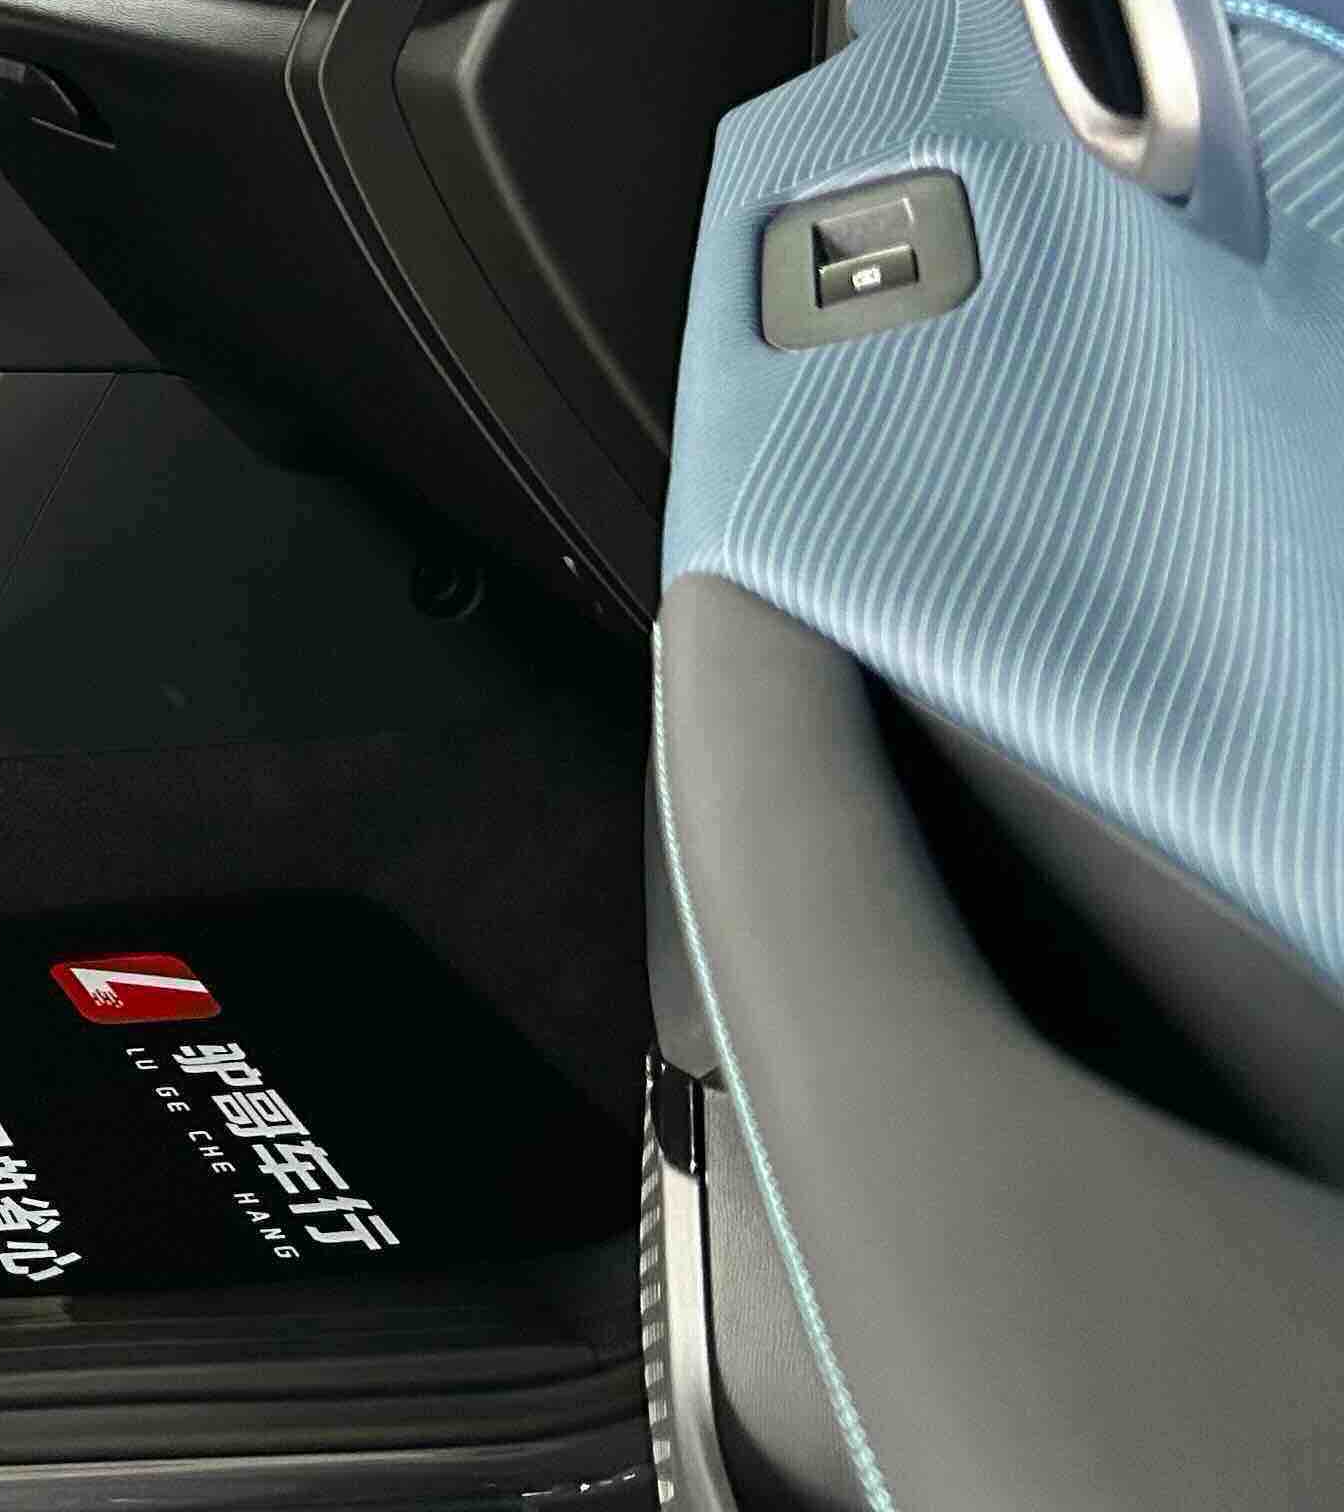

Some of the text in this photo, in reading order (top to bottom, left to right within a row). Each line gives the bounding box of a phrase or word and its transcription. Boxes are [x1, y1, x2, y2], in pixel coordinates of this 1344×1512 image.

[126, 1047, 300, 1258] LU GE CHE HANG
[171, 1042, 401, 1252] 驴哥车行
